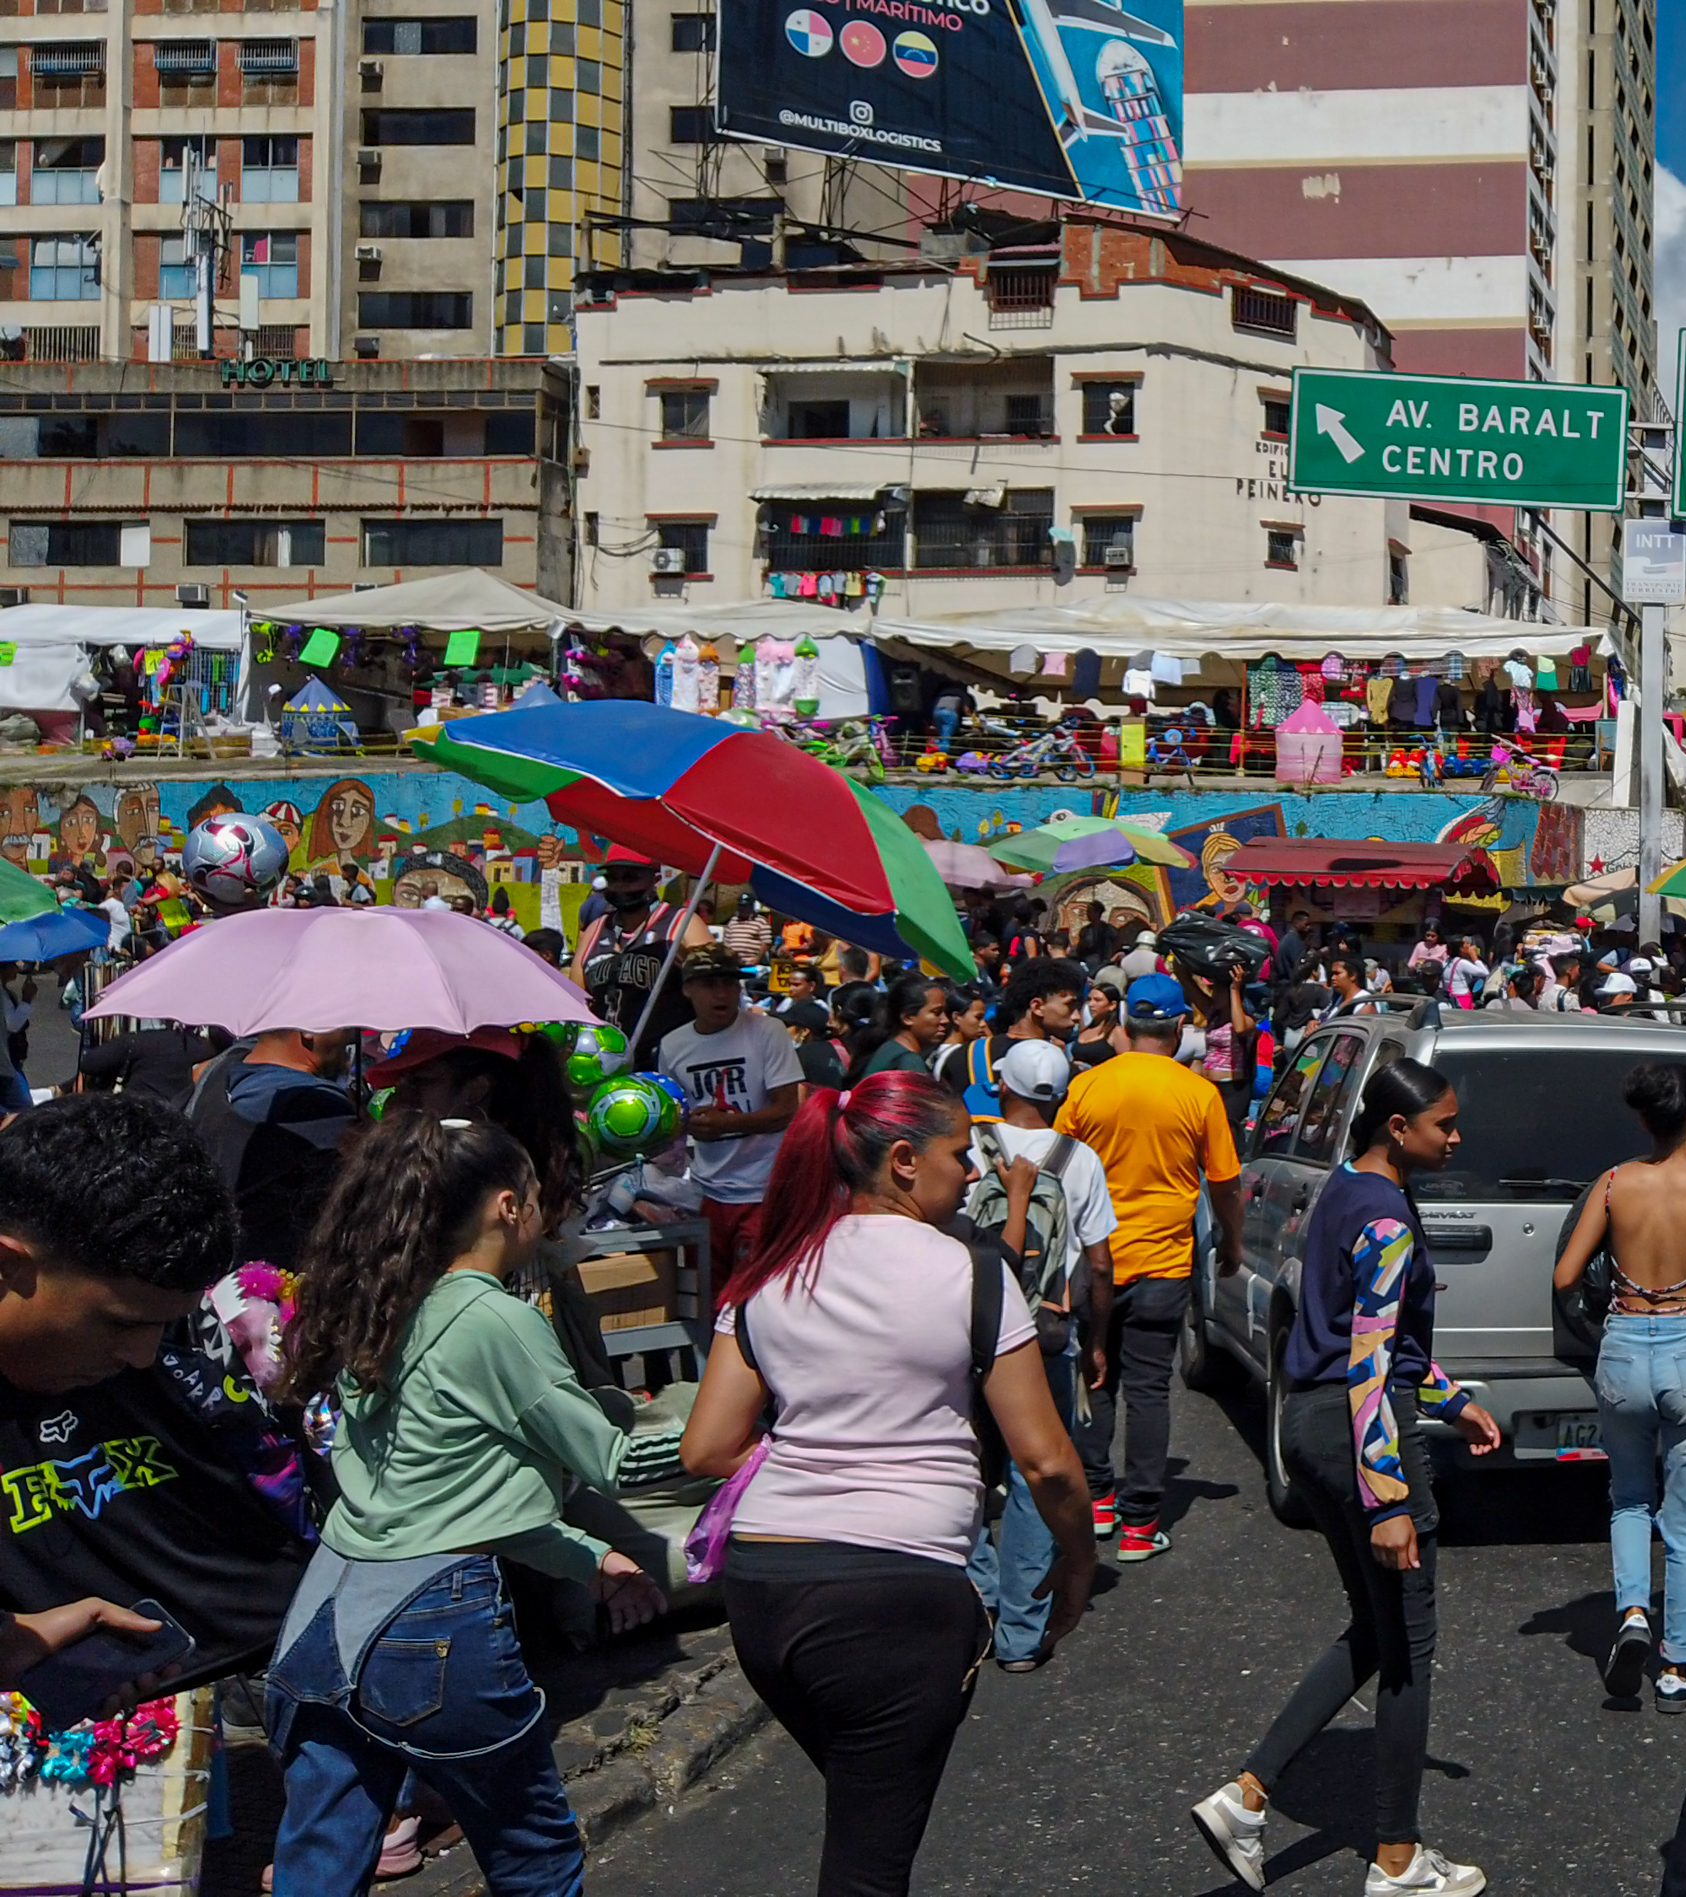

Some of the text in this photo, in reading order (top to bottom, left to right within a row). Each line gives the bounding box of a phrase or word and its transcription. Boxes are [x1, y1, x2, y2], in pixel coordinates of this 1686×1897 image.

[861, 0, 963, 31] MARÍTIMO
[778, 109, 943, 153] @MULTIBOXLOGISTICS
[220, 358, 333, 383] HOTEL
[1385, 399, 1605, 440] AV. BARALT
[1382, 445, 1524, 481] CENTRO
[1636, 533, 1675, 549] INTT
[691, 1066, 747, 1100] JOR
[1563, 1423, 1604, 1448] AG2
